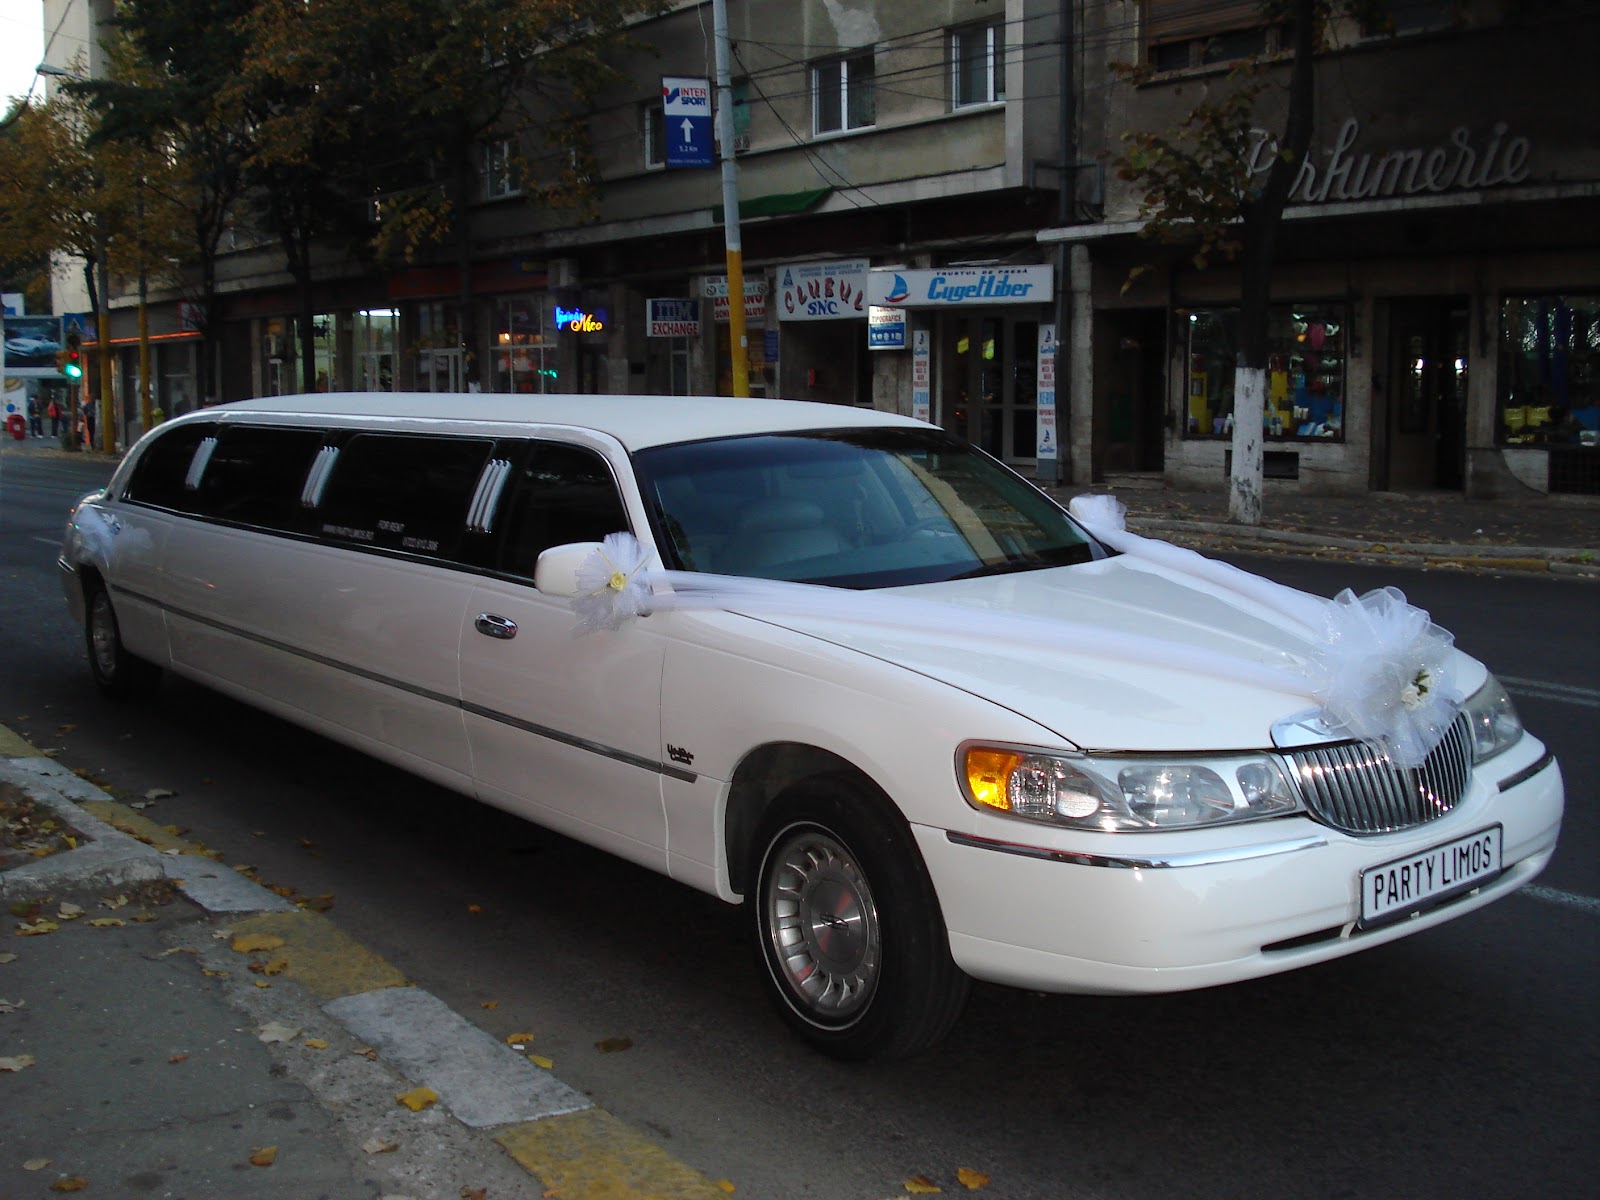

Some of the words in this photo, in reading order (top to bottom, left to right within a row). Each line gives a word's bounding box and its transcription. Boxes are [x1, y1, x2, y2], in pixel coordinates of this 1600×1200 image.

[680, 87, 707, 97] INTER
[681, 97, 706, 106] SPORT
[1246, 119, 1531, 201] Prfumerie
[652, 322, 698, 336] EXCHANGE
[1374, 855, 1435, 910] PARTY
[1442, 836, 1491, 885] LIMOS
